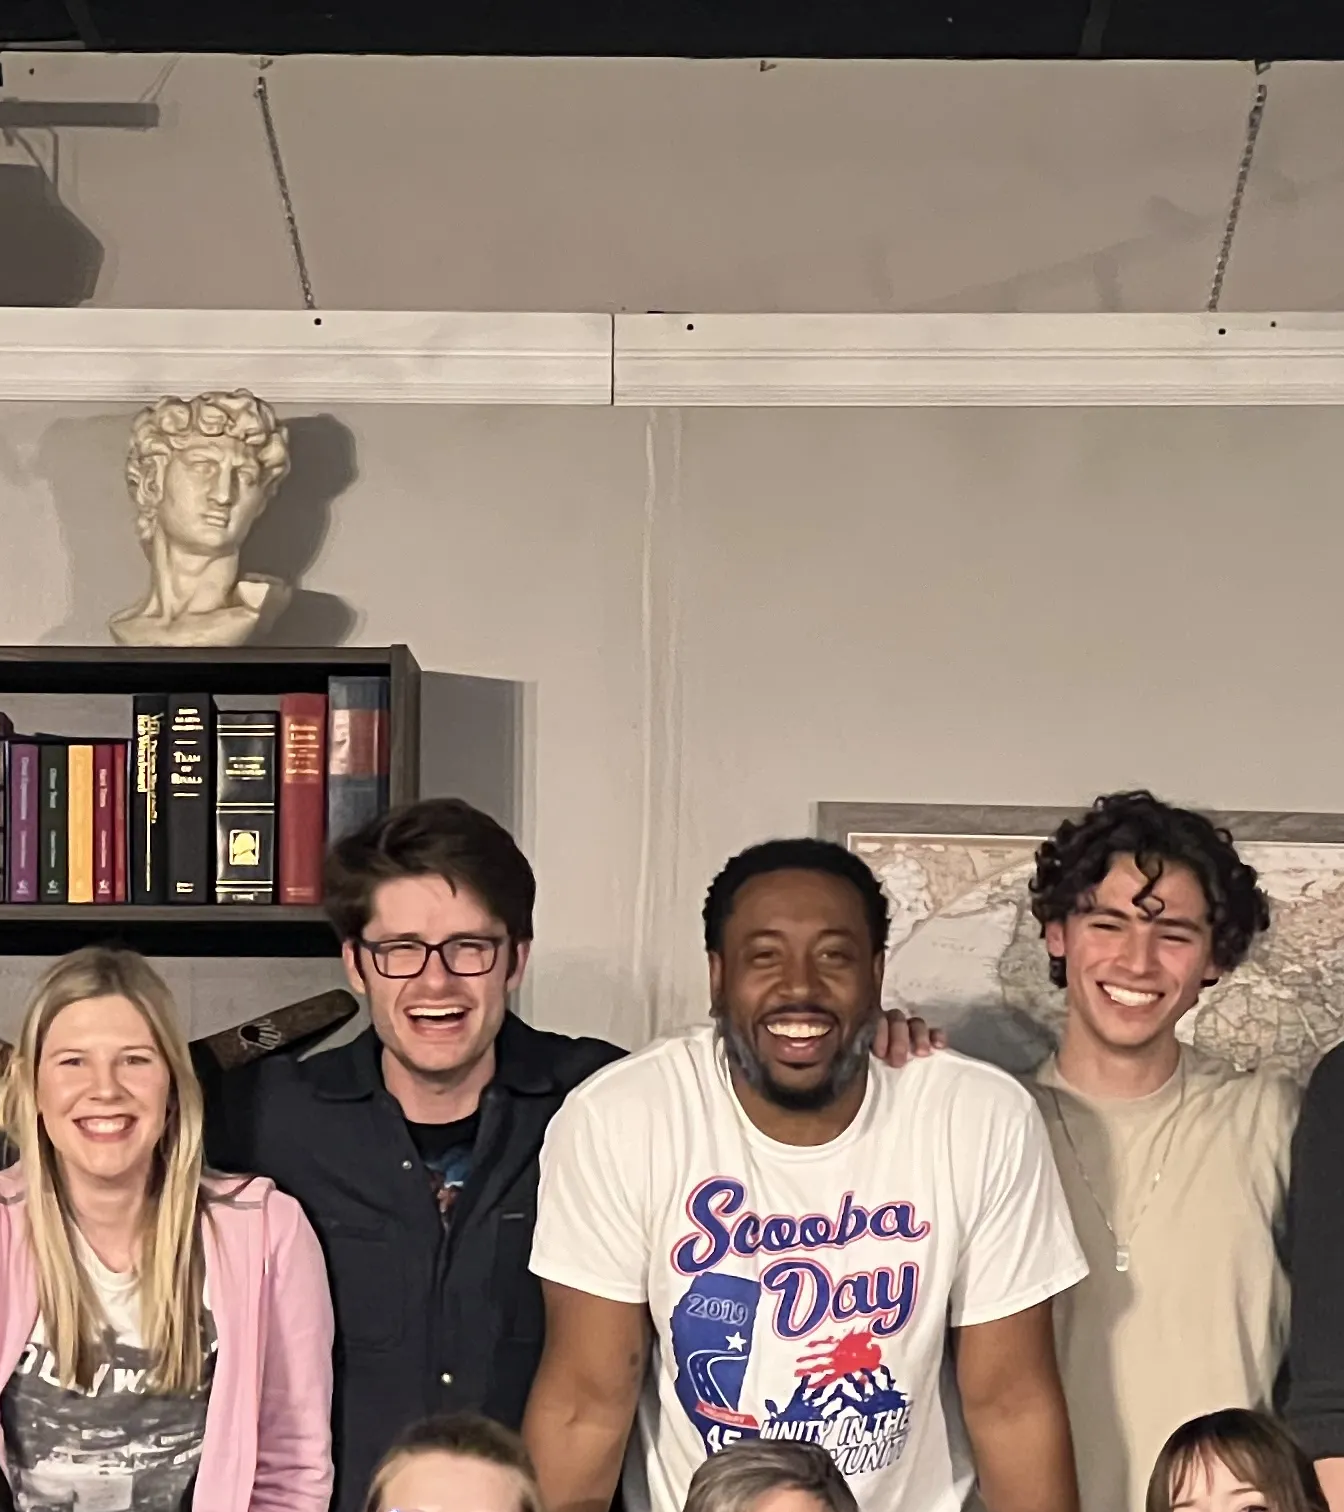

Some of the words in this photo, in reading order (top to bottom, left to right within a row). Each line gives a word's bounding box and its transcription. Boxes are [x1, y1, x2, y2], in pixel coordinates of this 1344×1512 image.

[669, 1174, 931, 1277] Scooba
[685, 1292, 750, 1326] 2019
[759, 1257, 920, 1342] Day
[759, 1419, 834, 1446] UNITY
[836, 1414, 868, 1447] IN
